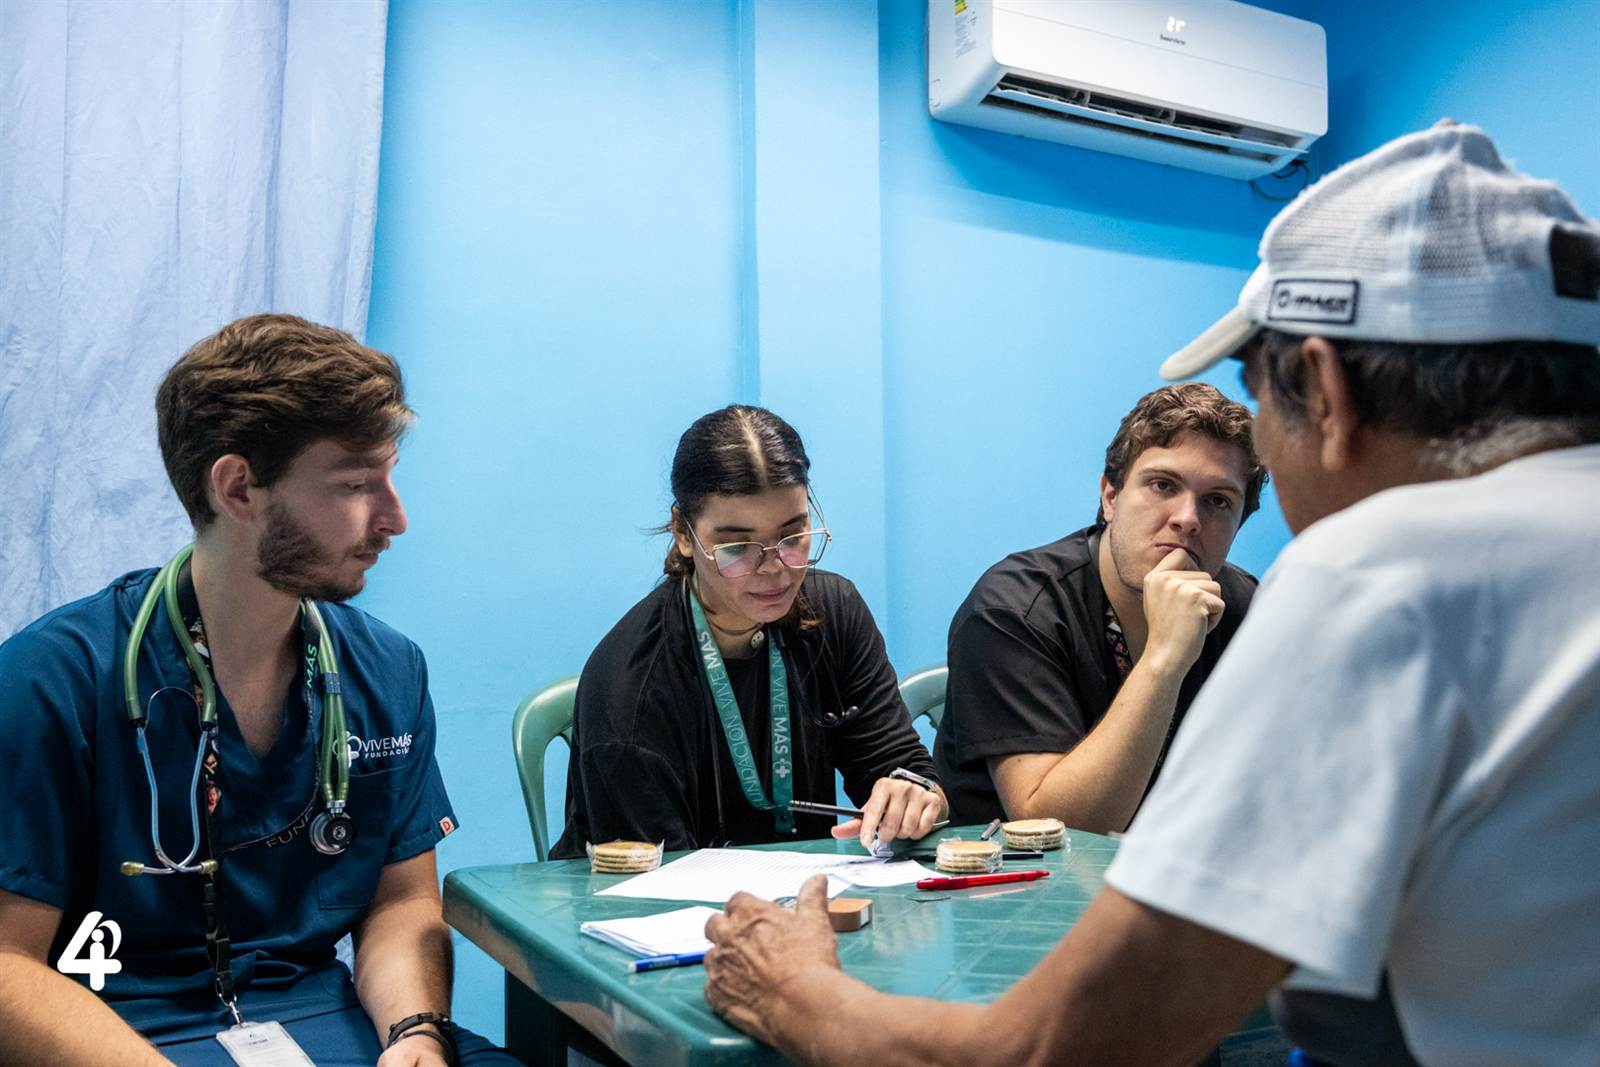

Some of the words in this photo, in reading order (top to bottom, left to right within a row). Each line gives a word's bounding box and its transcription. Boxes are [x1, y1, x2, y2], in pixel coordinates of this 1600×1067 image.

[699, 631, 721, 669] MAS
[710, 670, 733, 710] VIVE
[772, 676, 787, 713] VIVE
[774, 717, 788, 754] MAS
[725, 713, 768, 806] UNDACION
